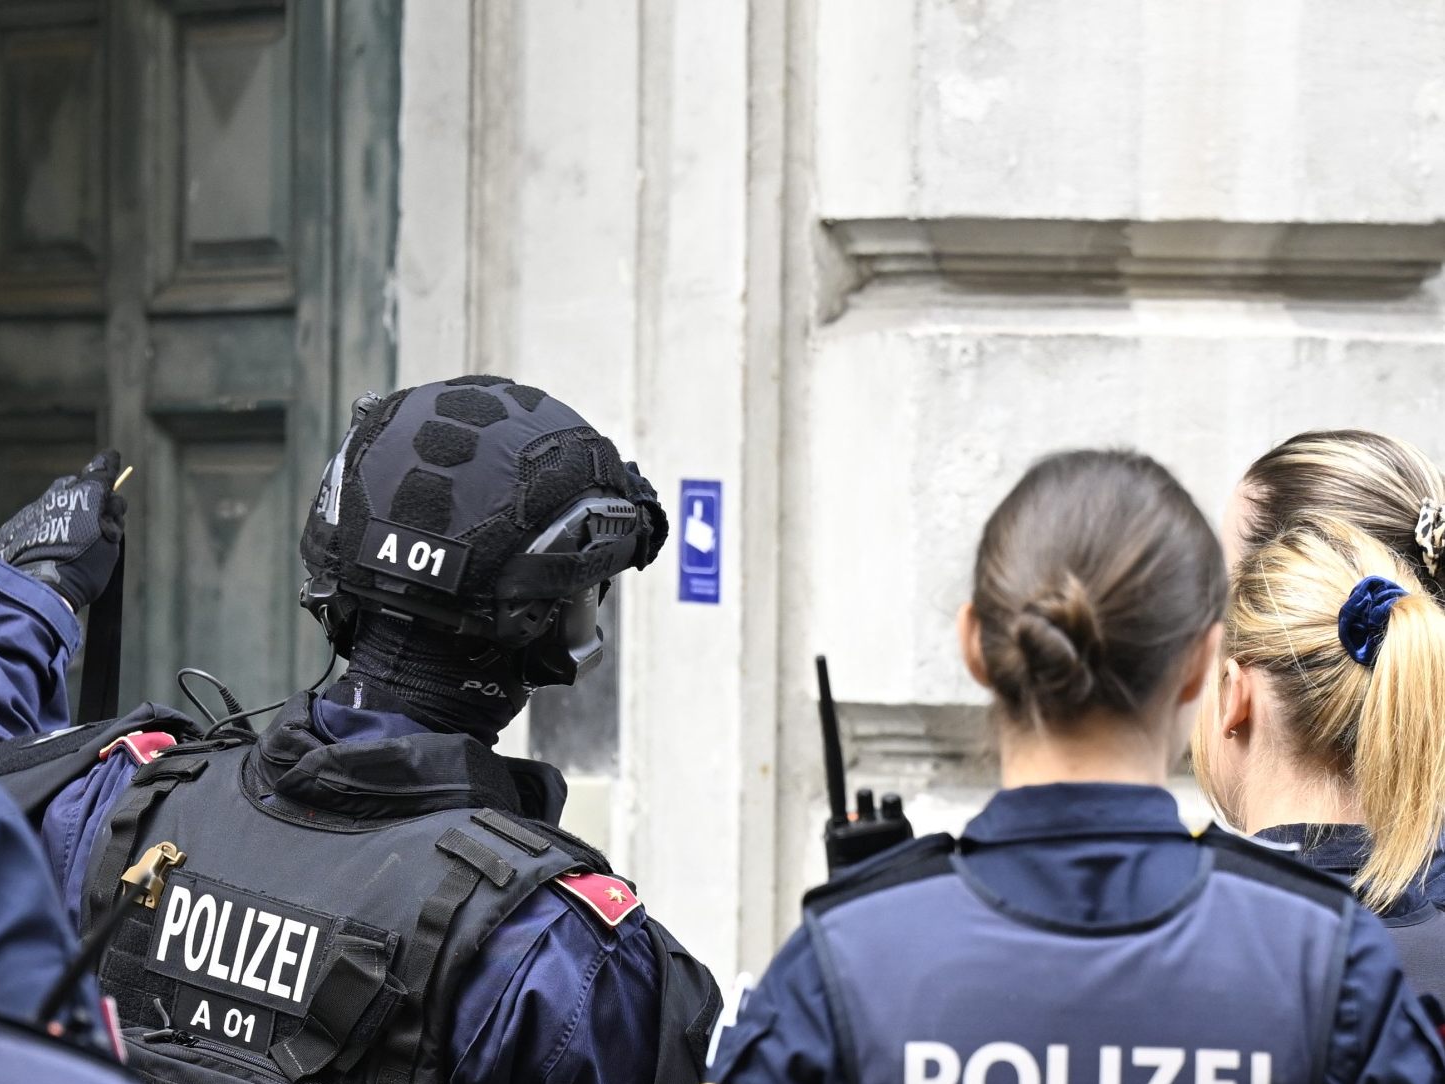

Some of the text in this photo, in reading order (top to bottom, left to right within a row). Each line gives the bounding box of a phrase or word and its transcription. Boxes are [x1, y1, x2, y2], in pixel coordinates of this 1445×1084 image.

[377, 533, 446, 577] A 01
[459, 680, 507, 697] PO
[156, 885, 319, 1002] POLIZEI
[190, 1000, 256, 1042] A 01
